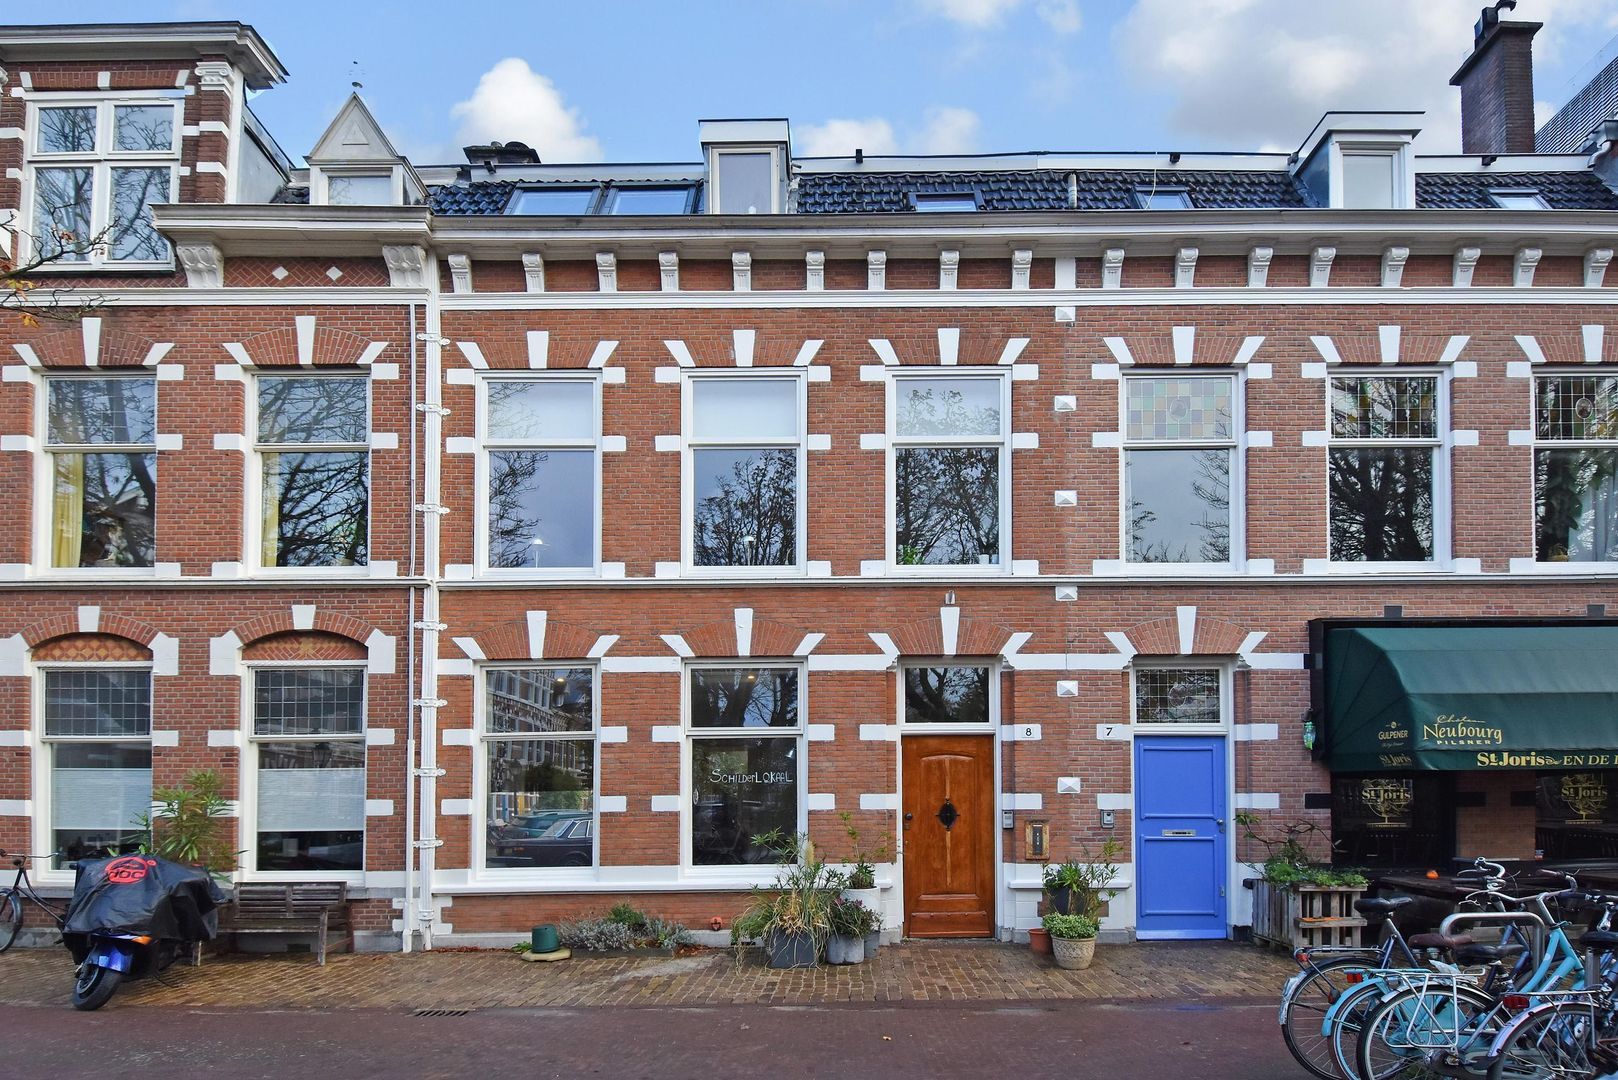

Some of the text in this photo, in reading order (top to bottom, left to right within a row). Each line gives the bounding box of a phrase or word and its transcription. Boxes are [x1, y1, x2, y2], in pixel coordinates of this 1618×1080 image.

[1025, 727, 1032, 737] 8
[1106, 727, 1113, 737] 7
[1378, 730, 1408, 740] GULPENER
[1423, 722, 1502, 745] Neubourg
[1563, 755, 1585, 766] EN
[1587, 755, 1609, 765] DE
[1377, 788, 1411, 803] Joris
[1575, 786, 1608, 800] Joris
